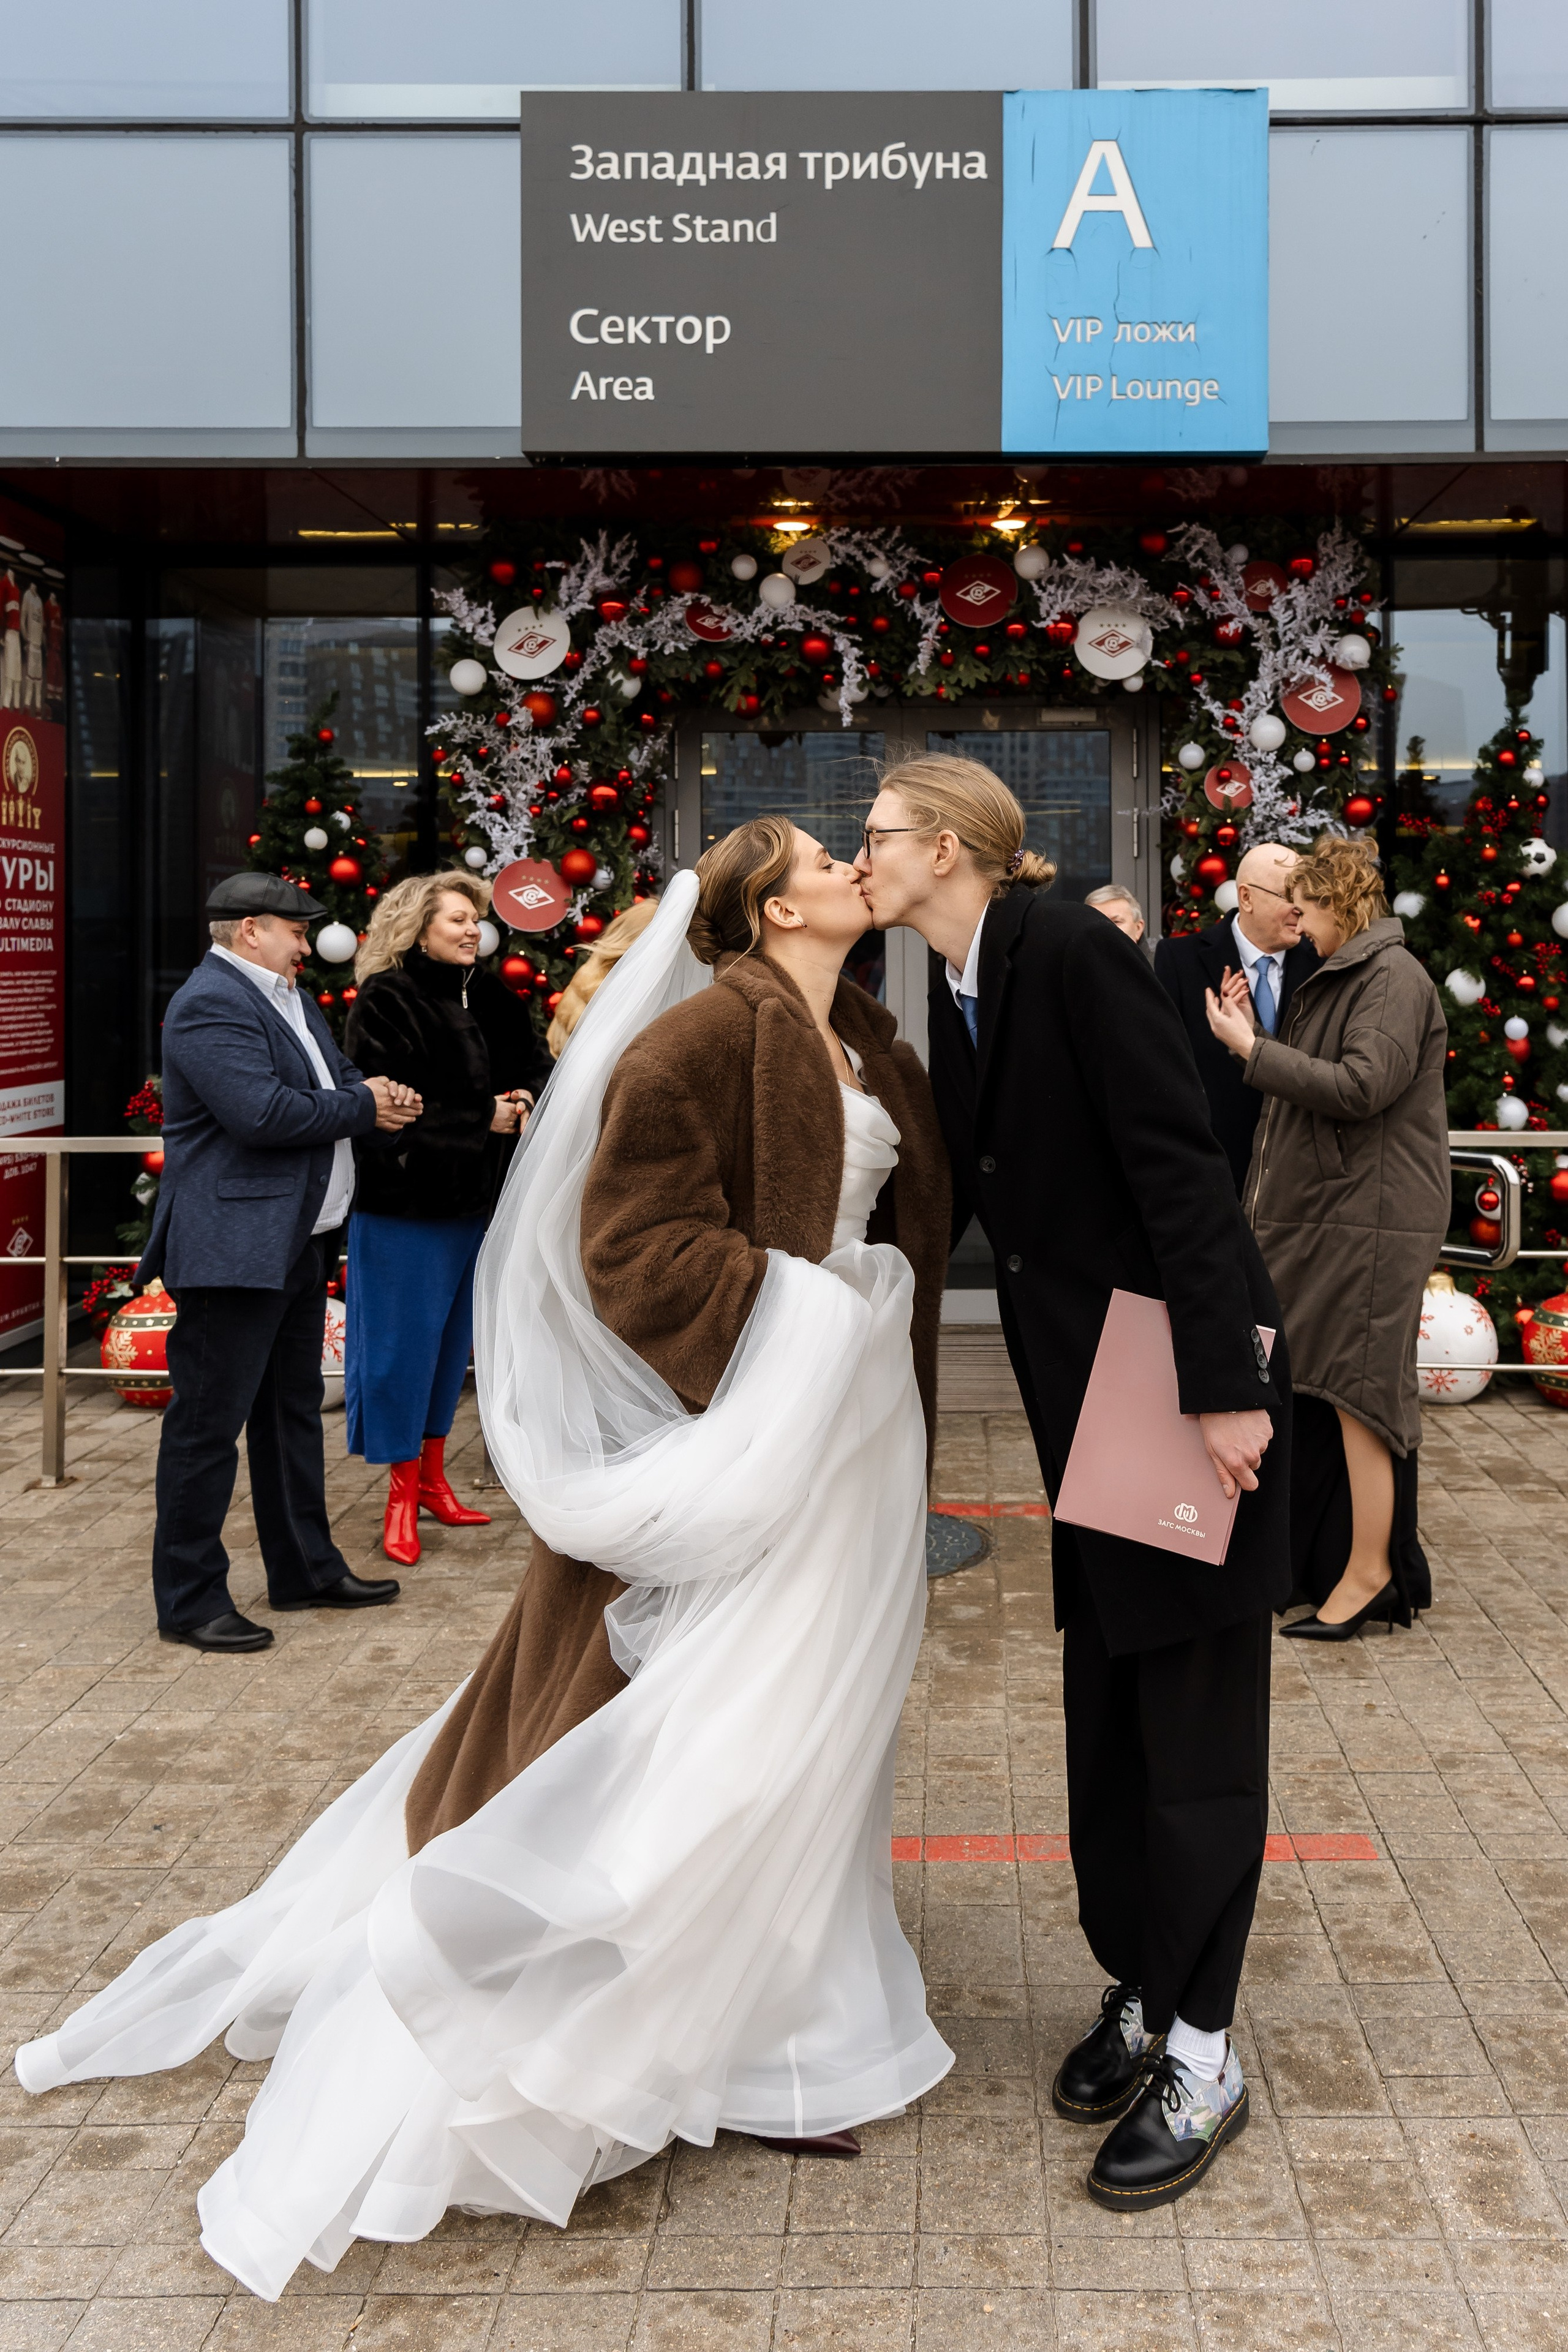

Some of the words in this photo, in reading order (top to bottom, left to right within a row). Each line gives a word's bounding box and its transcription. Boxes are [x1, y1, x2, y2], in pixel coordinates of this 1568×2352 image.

[570, 145, 787, 186] Западная
[799, 142, 988, 189] трибуна
[570, 214, 664, 243] West
[672, 212, 777, 243] Stand
[569, 309, 731, 354] Сектор
[1053, 320, 1102, 343] VIP
[1114, 320, 1196, 343] ложи
[570, 371, 655, 401] Area
[1053, 375, 1102, 399] VIP
[1111, 375, 1219, 405] Lounge
[0, 856, 54, 891] УРЫ
[1158, 1519, 1174, 1529] ЗАГС
[1175, 1524, 1205, 1538] МОСКВЫ
